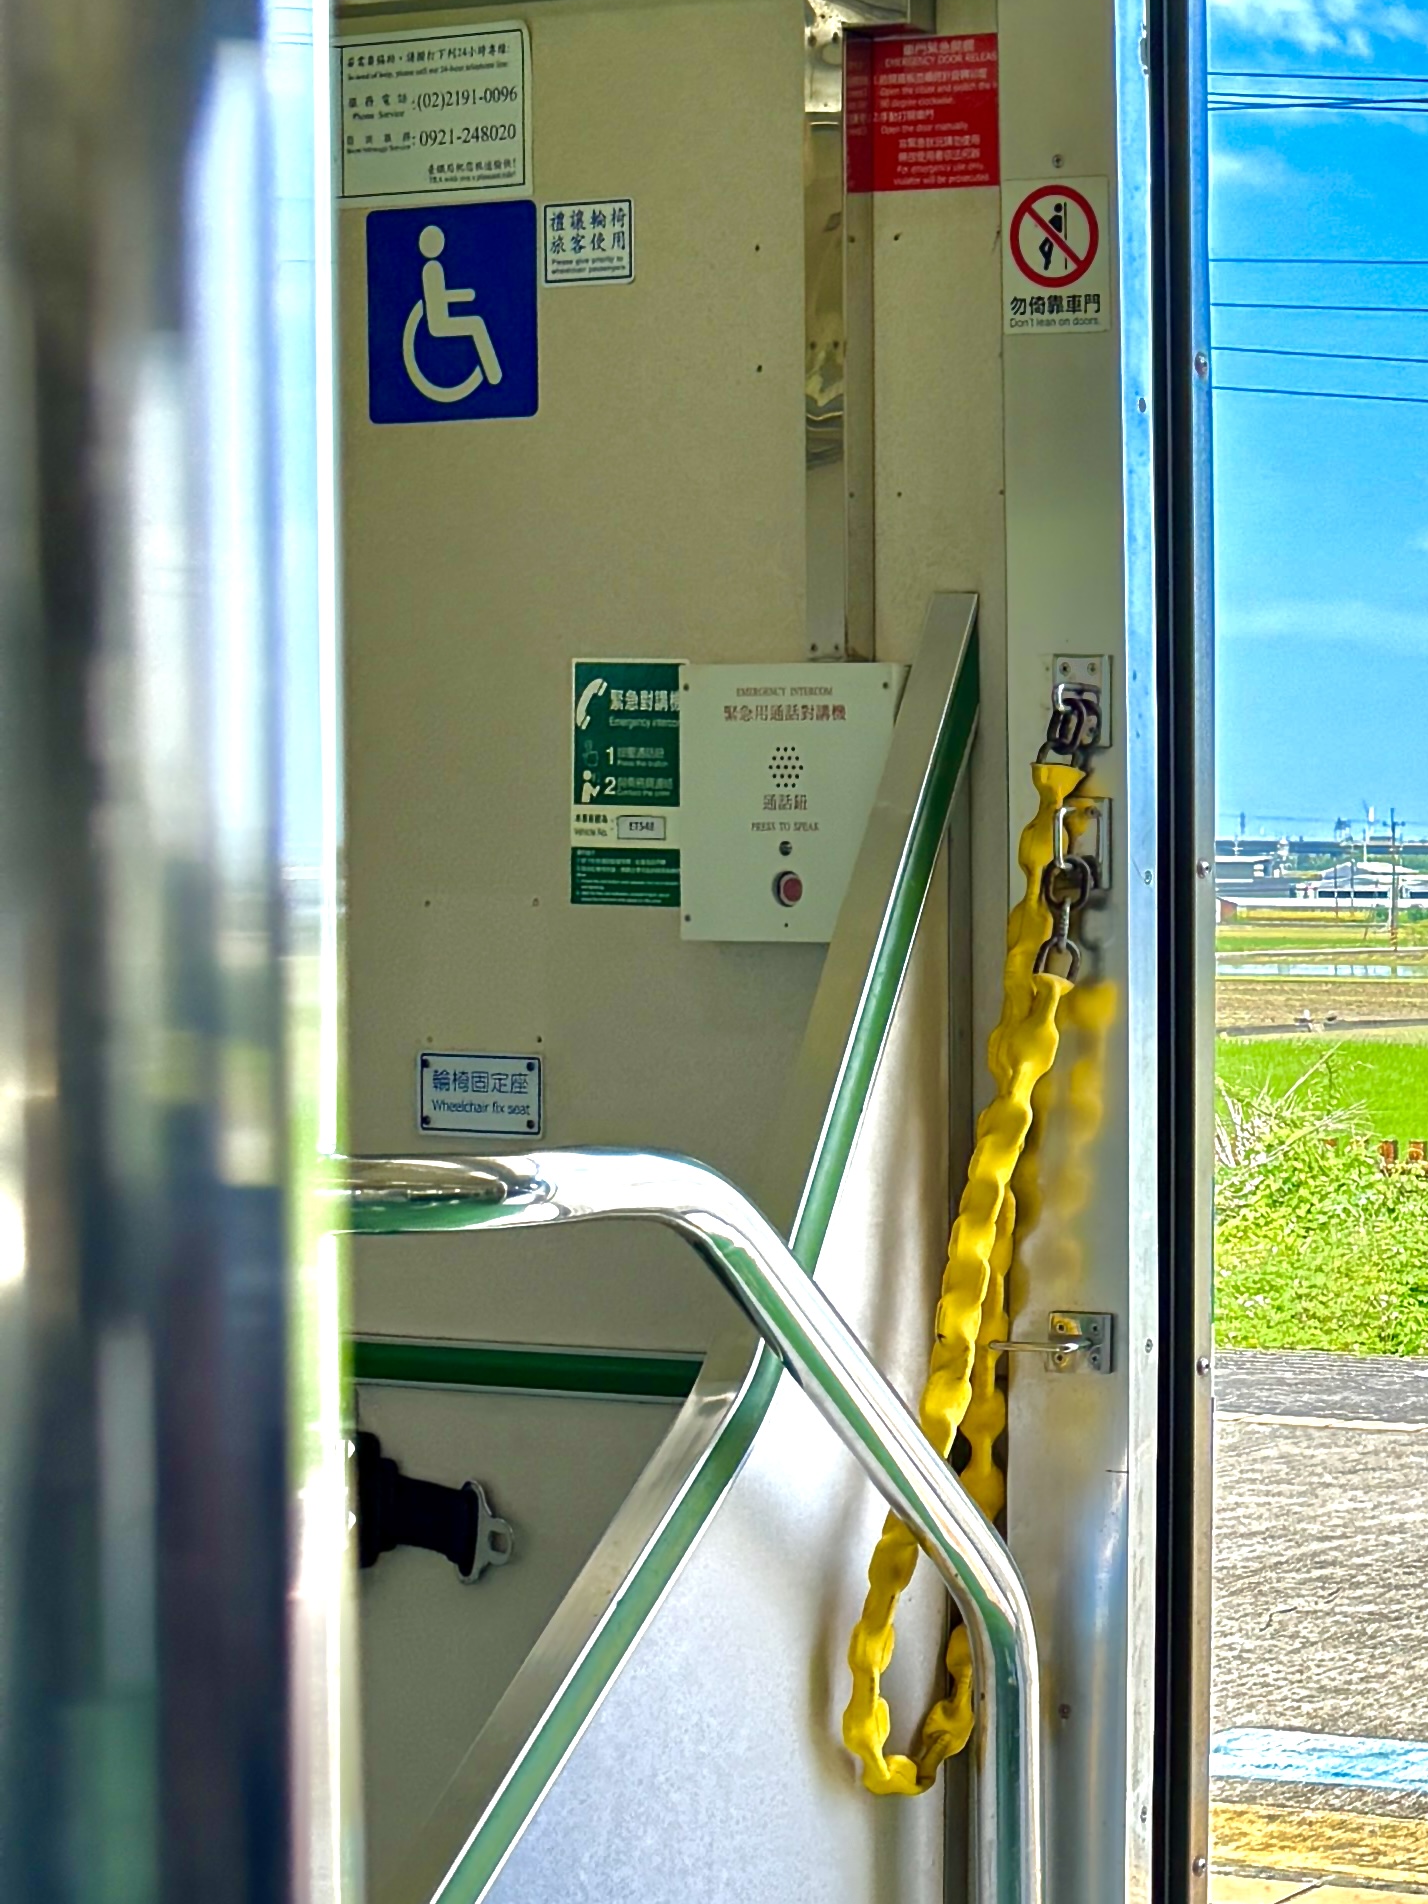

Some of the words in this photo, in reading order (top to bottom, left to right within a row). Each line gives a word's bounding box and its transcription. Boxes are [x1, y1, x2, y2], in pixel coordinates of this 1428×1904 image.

[418, 123, 518, 147] 0921-248020
[549, 207, 627, 232] 禮讓輪椅
[550, 230, 626, 255] 旅客使用
[1009, 293, 1101, 316] 勿倚靠車門
[723, 704, 847, 722] 緊急用通話對講機
[605, 746, 614, 766] 1
[603, 776, 617, 795] 2
[431, 1069, 530, 1095] 輪椅固定座
[431, 1098, 491, 1114] Wheelchair
